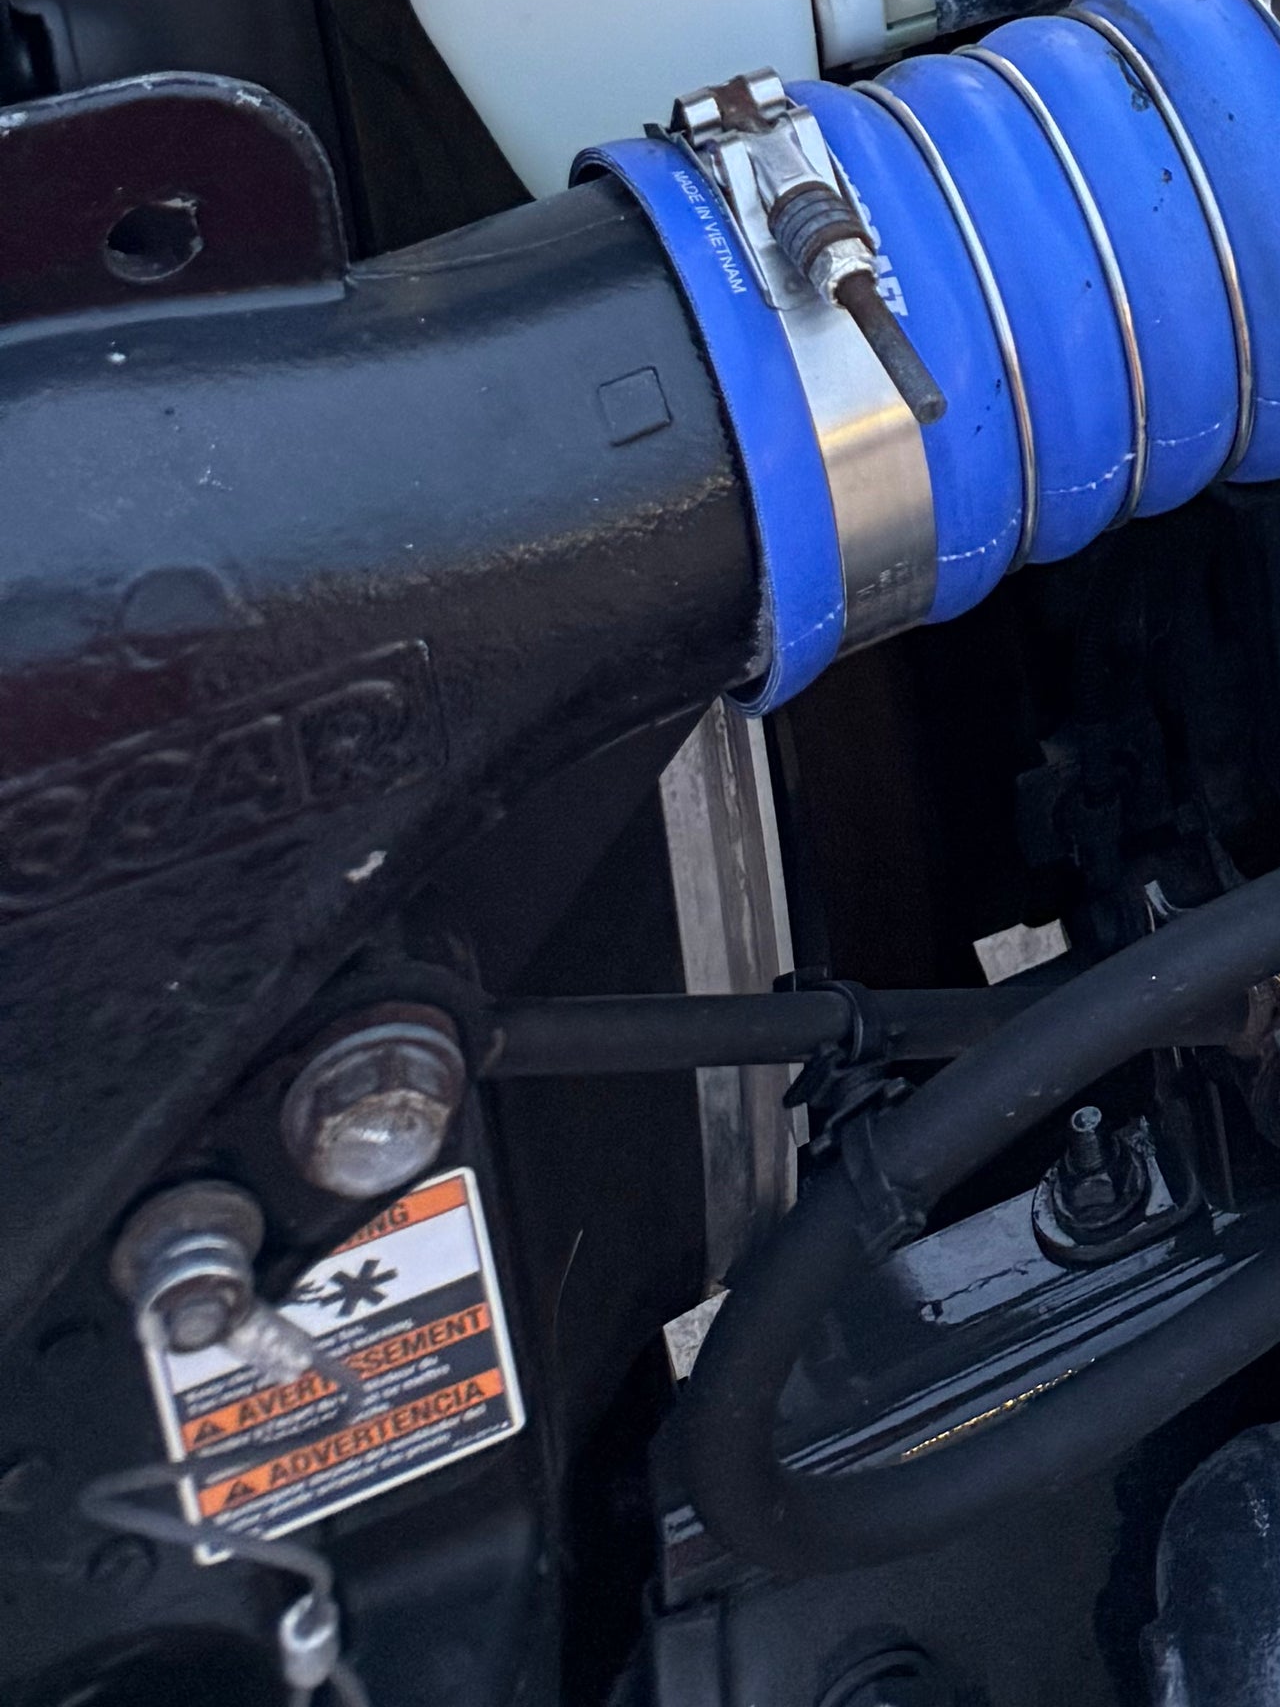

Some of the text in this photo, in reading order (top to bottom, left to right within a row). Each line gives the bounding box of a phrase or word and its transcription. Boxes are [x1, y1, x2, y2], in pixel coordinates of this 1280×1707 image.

[671, 169, 748, 295] MADE IN VIETNAM
[268, 1379, 487, 1488] ADVERTENCIA
